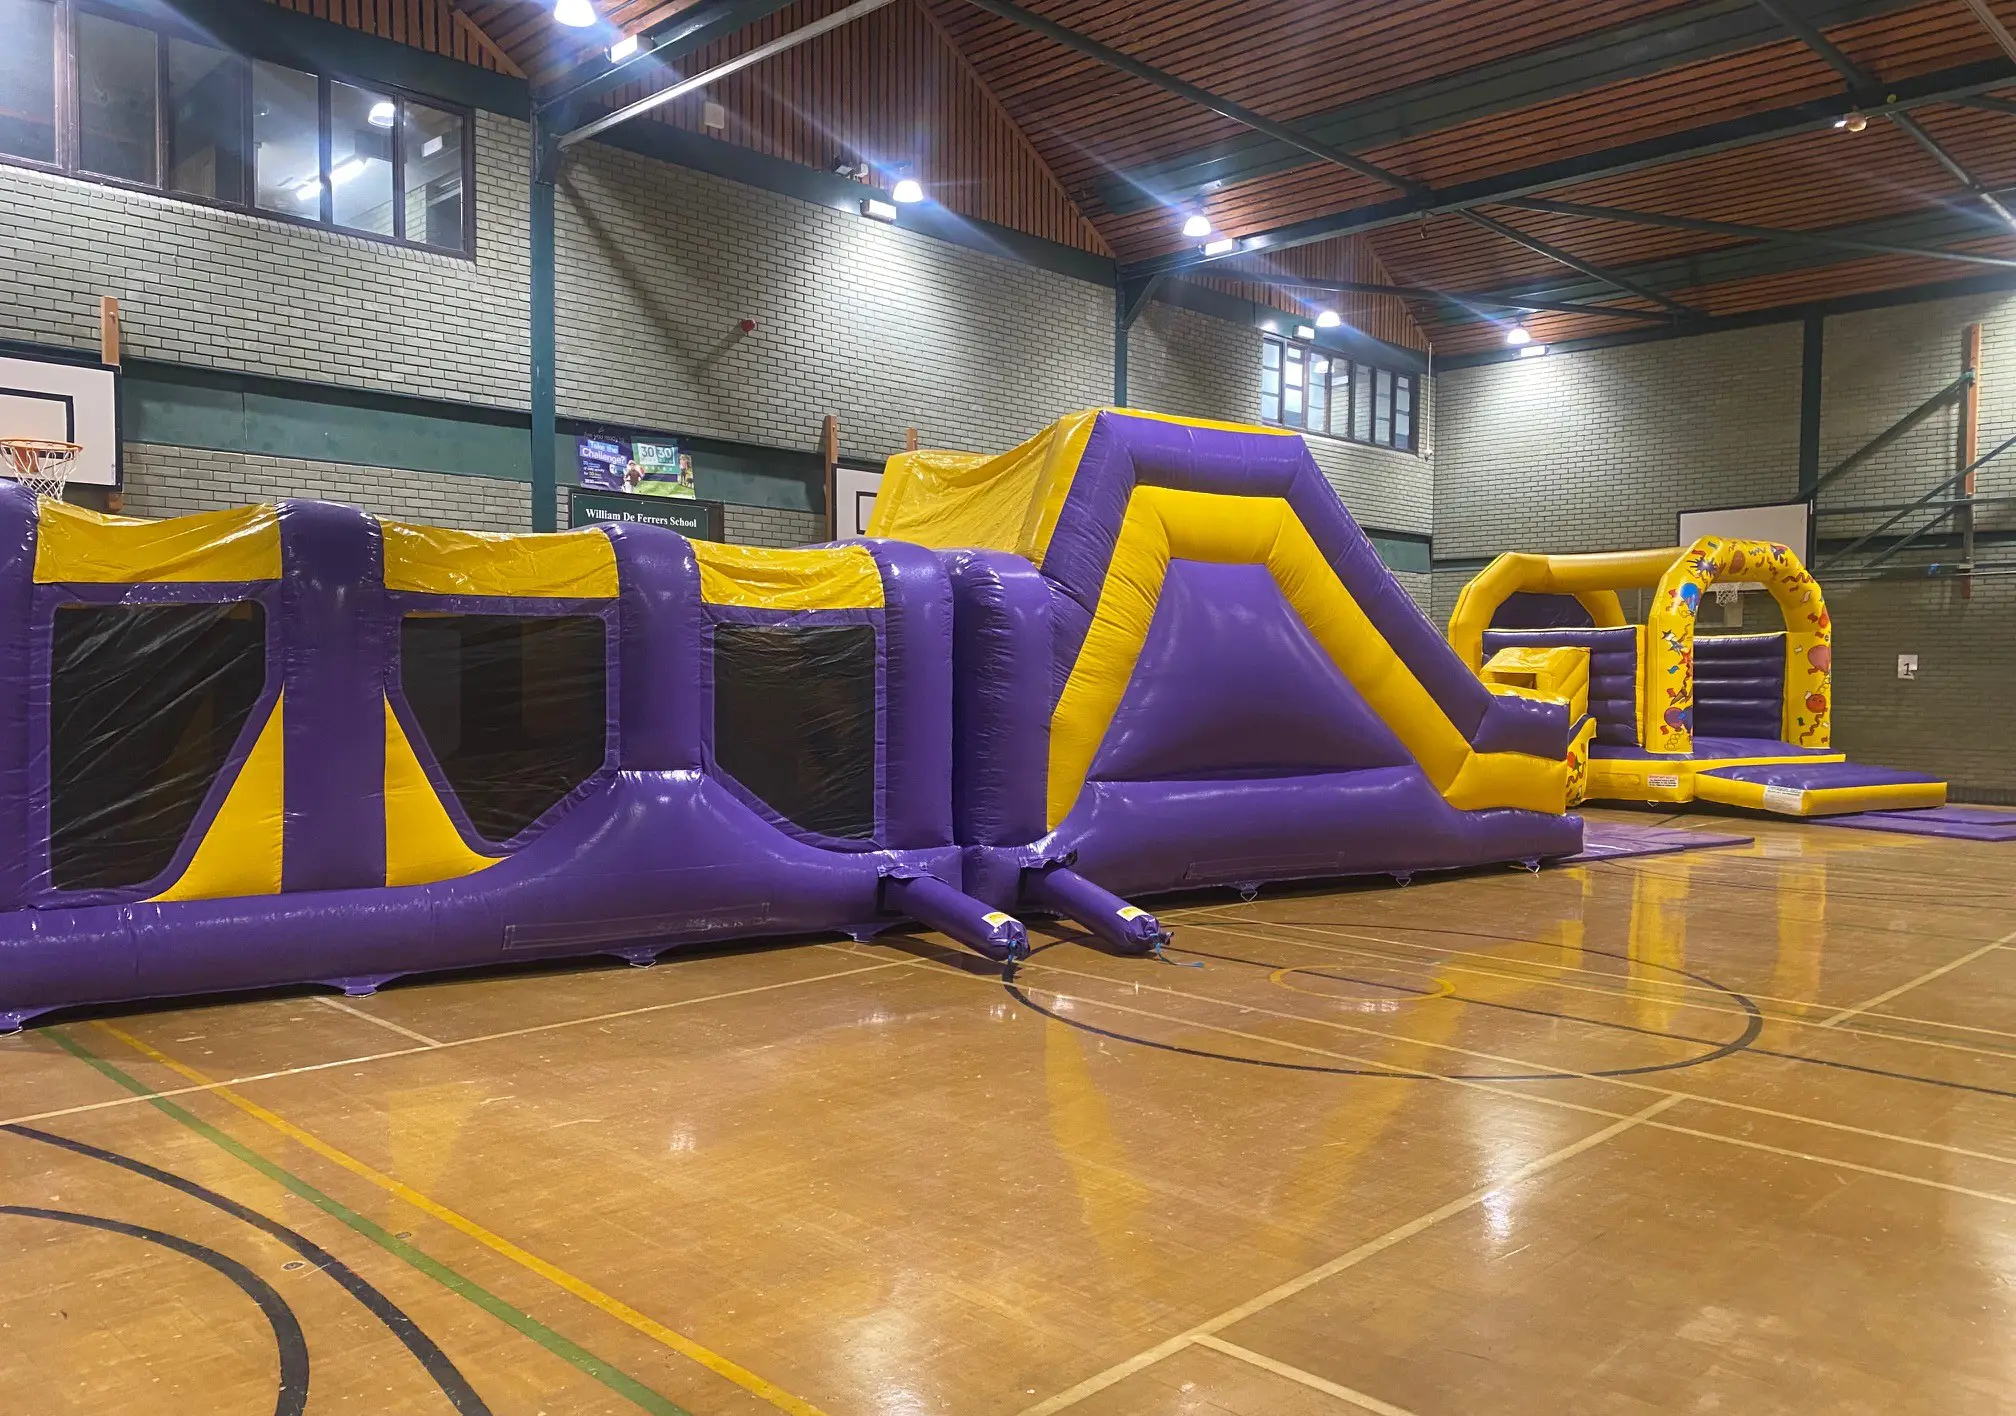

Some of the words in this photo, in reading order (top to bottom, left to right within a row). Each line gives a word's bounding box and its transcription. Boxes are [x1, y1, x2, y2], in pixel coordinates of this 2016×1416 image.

[589, 440, 605, 451] Take
[606, 444, 618, 453] the
[640, 446, 655, 457] 30
[656, 447, 672, 458] 30
[582, 447, 625, 464] Challenge?
[586, 508, 621, 520] William
[623, 512, 635, 522] De
[637, 514, 668, 525] Ferrers
[670, 516, 697, 528] School
